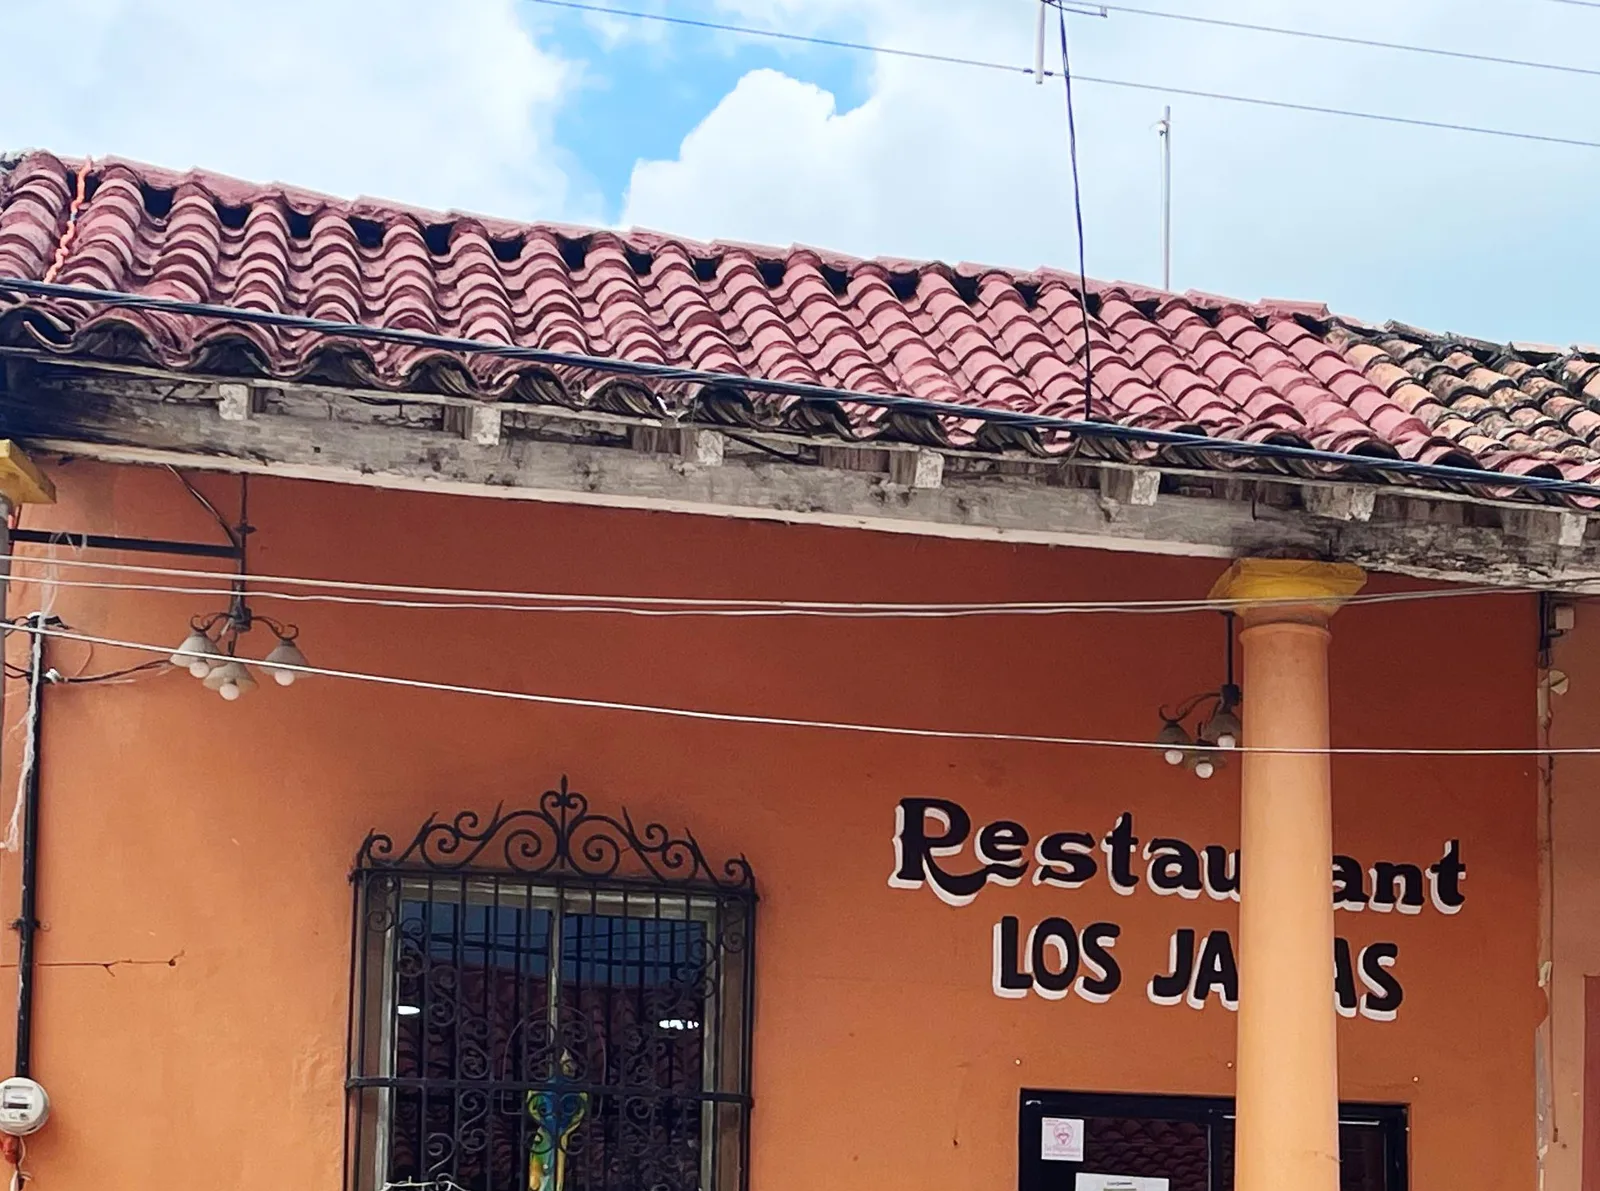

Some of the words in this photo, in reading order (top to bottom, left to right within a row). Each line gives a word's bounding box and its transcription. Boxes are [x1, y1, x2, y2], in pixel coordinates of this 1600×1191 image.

[888, 798, 1467, 914] Restauant
[993, 916, 1122, 1004] LOS
[1147, 929, 1404, 1022] JAAS
